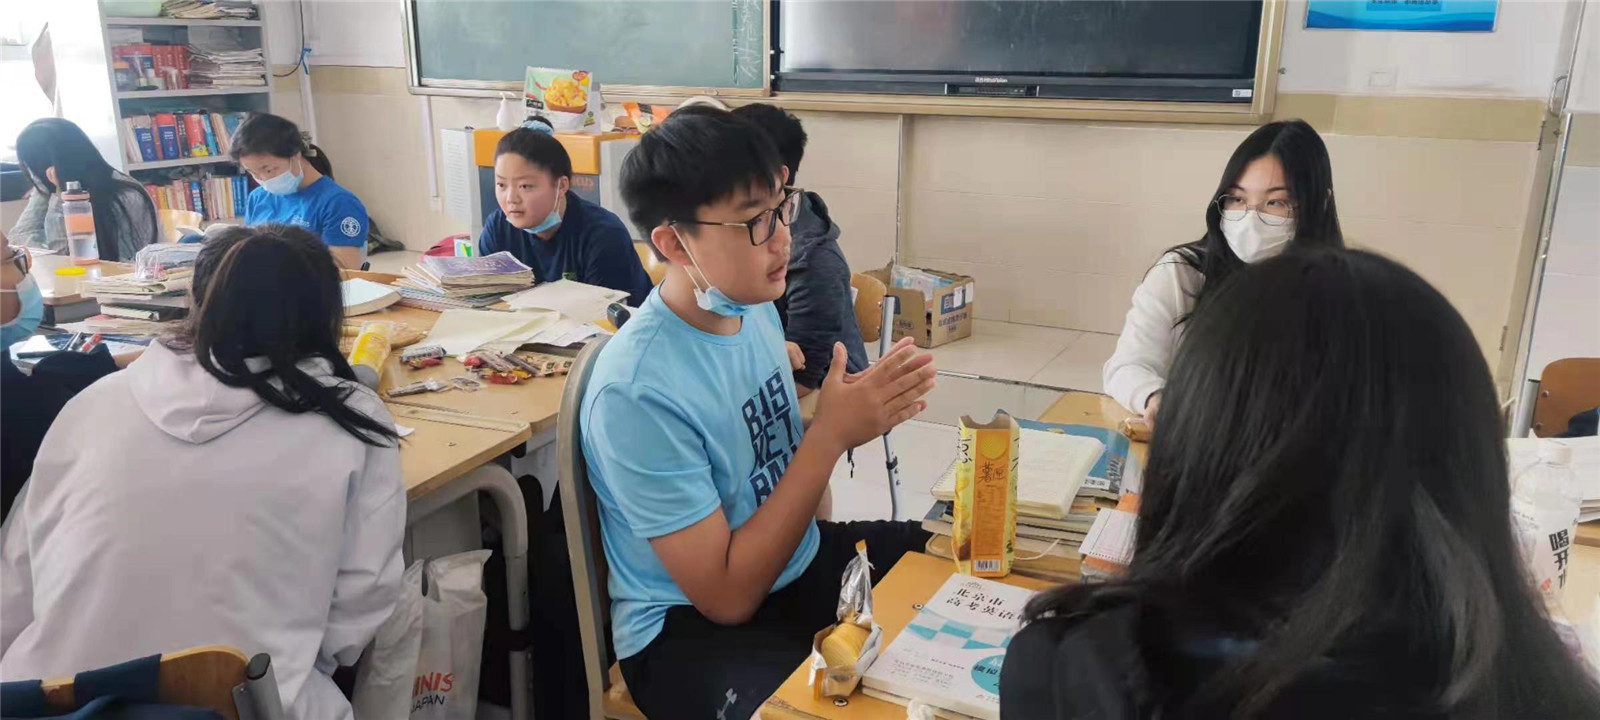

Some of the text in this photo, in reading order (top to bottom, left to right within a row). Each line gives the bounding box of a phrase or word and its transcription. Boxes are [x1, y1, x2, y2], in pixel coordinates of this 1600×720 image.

[752, 409, 793, 469] KET
[749, 444, 797, 508] BA
[946, 596, 1023, 620] 高考英语
[954, 587, 1006, 606] 北京市
[973, 662, 1000, 676] 模拟
